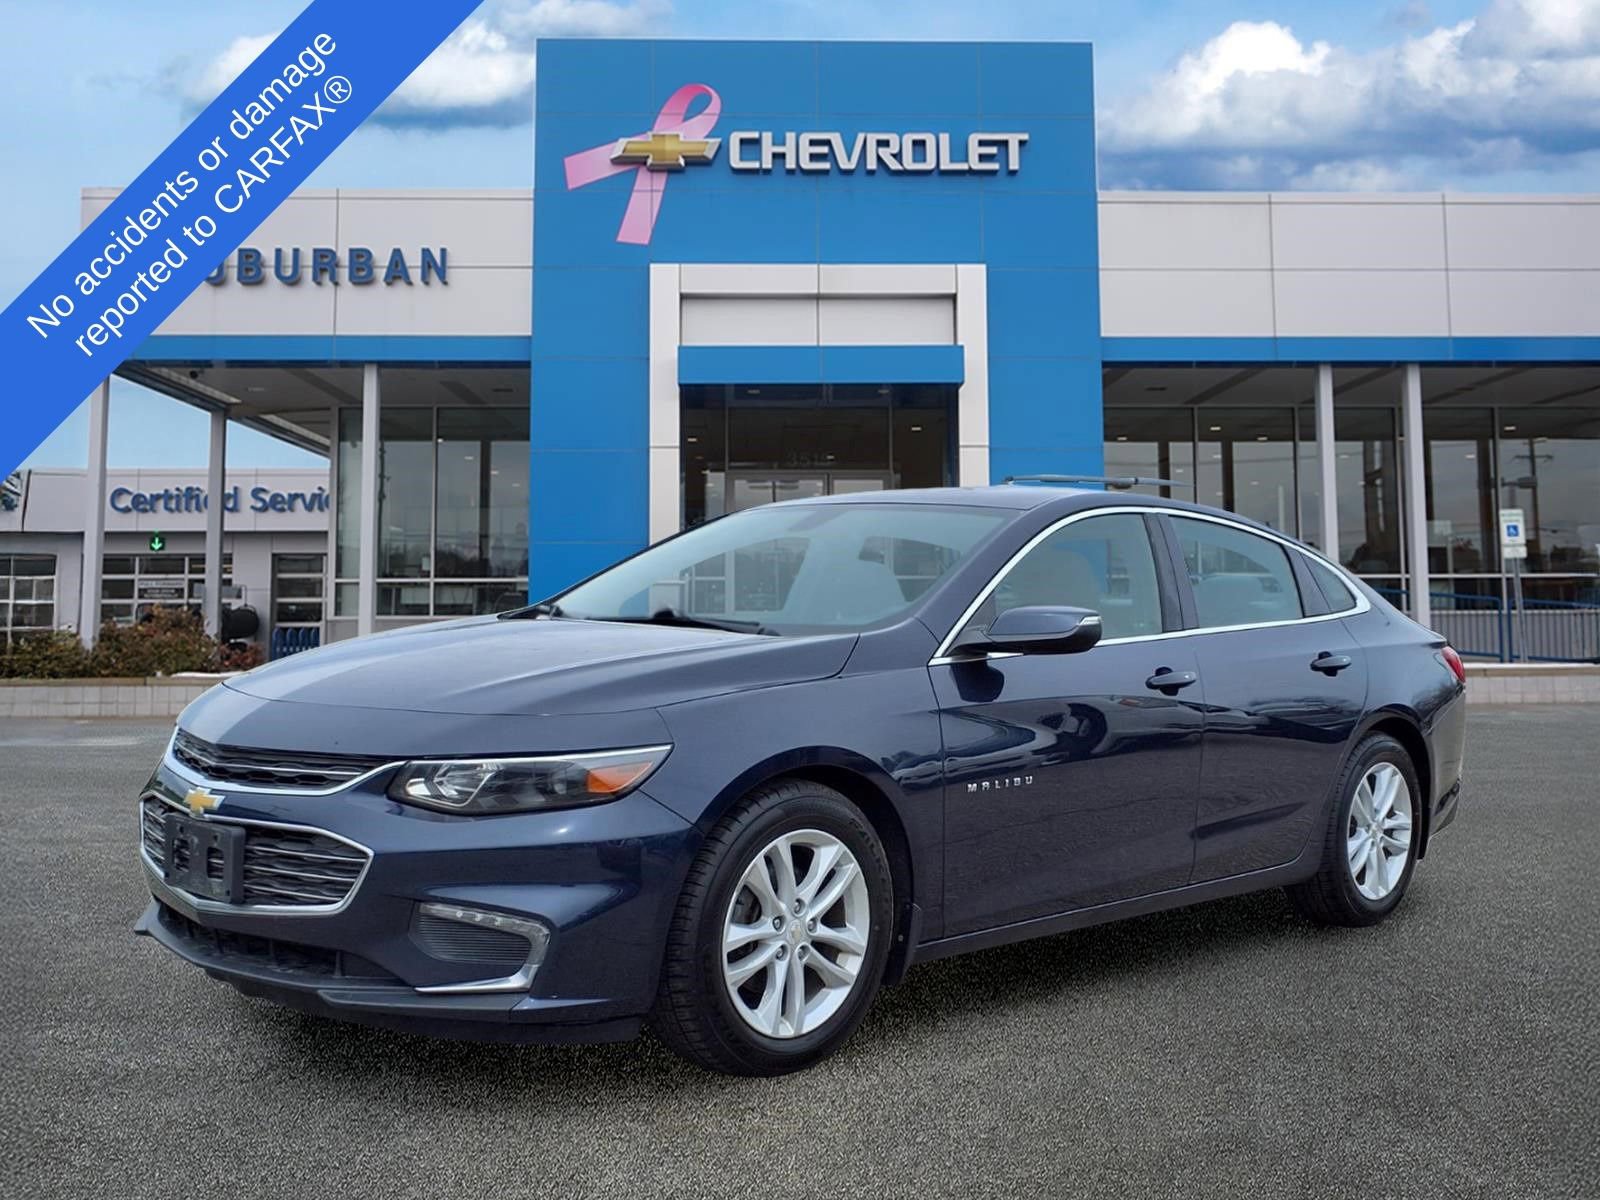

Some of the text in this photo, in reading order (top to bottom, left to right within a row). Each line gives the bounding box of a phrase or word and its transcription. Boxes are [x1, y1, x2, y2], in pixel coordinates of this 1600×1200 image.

[729, 131, 1029, 173] CHEVROLET
[205, 247, 449, 286] BURBAN
[967, 776, 1033, 793] MALIBU
